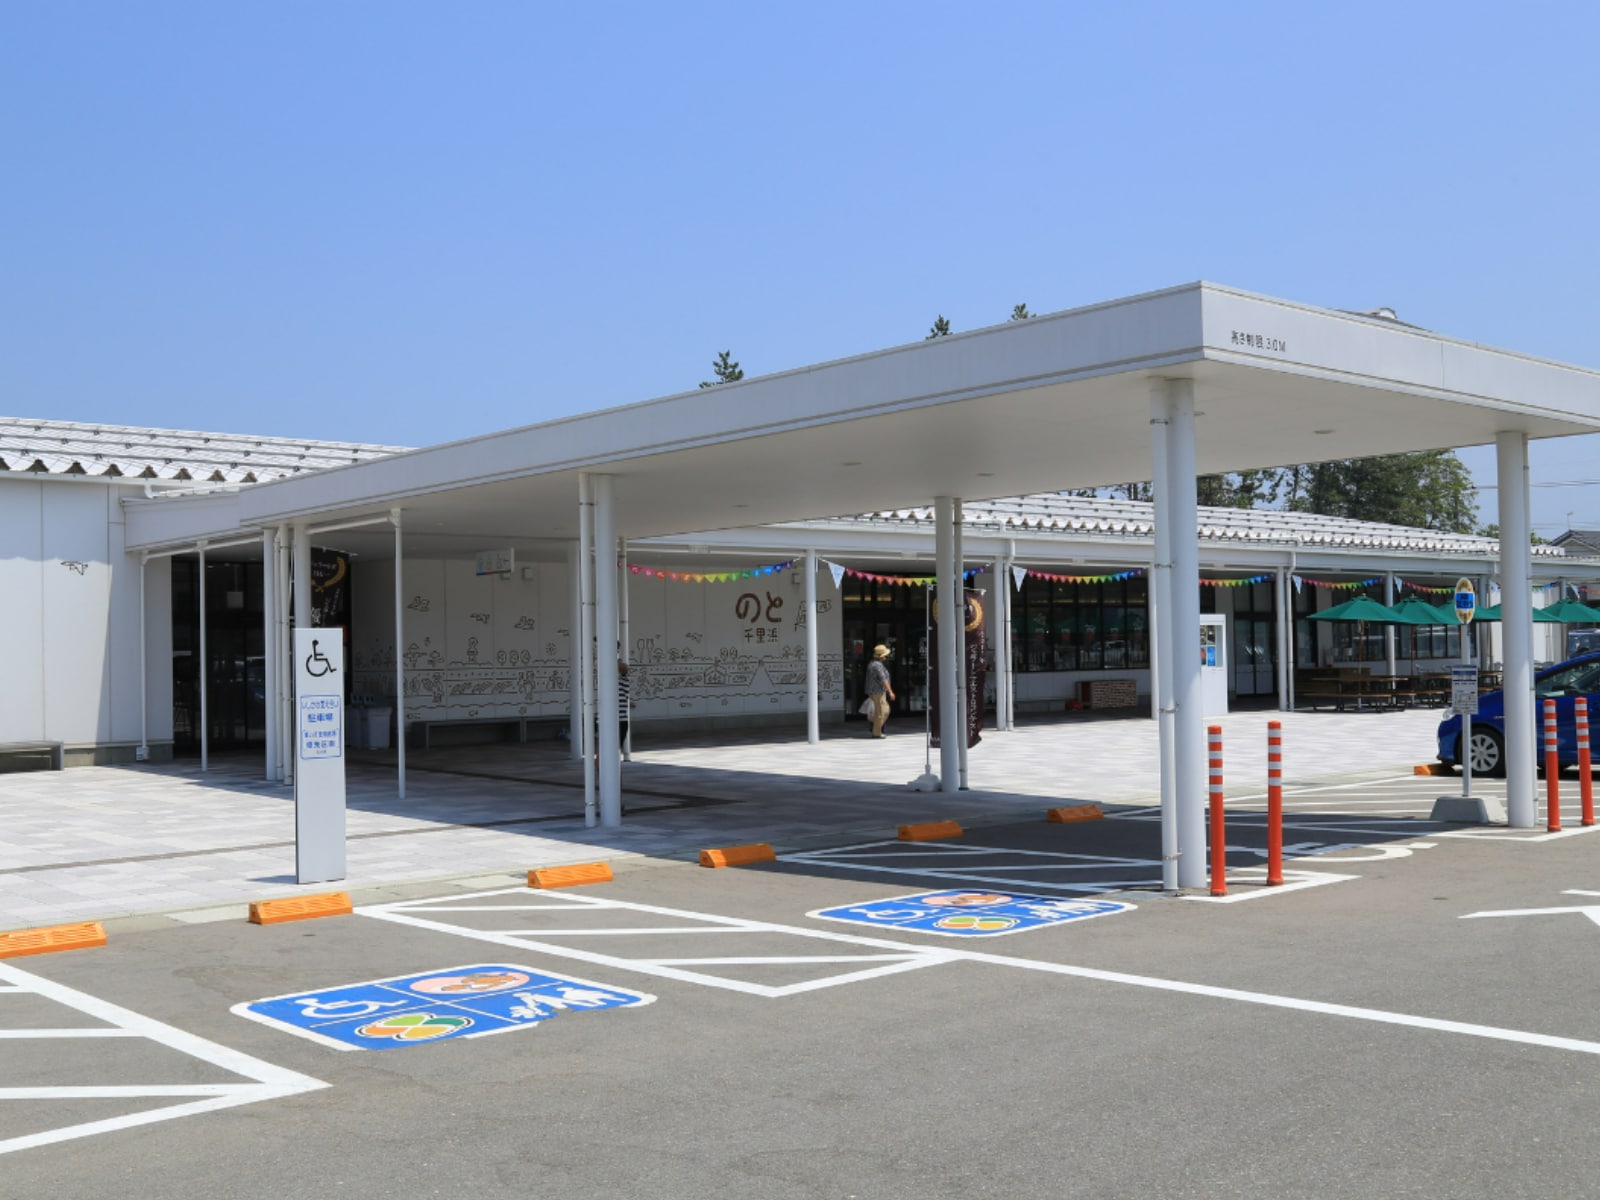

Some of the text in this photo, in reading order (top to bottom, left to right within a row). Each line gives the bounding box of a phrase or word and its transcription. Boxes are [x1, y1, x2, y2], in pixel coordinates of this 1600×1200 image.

[735, 591, 784, 624] のと
[744, 627, 778, 643] 千里浜
[307, 713, 333, 723] 駐車場
